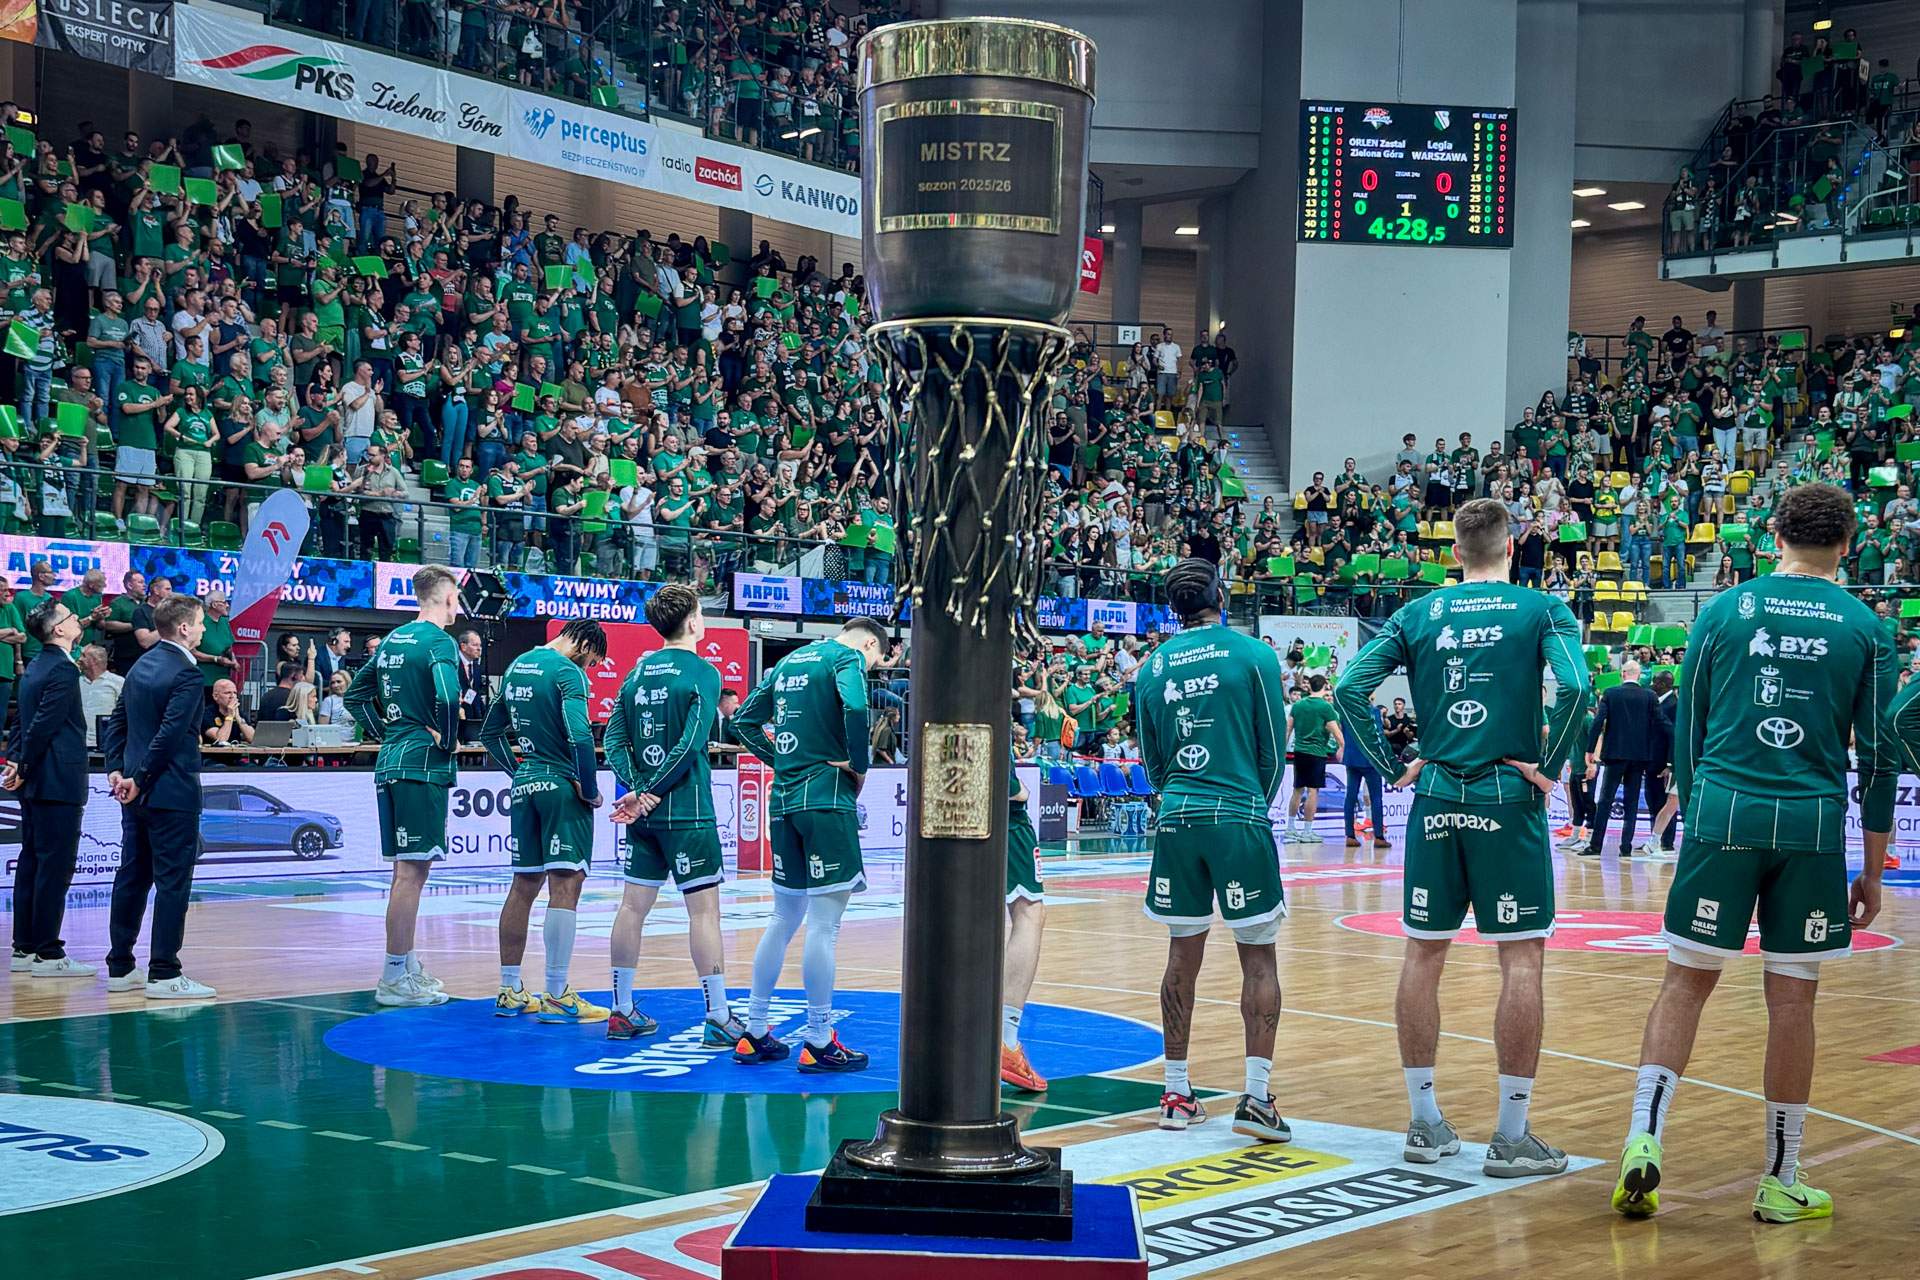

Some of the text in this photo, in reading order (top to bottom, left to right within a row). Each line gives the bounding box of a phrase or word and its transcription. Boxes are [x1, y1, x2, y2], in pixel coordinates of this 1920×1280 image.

[65, 23, 146, 54] EKSPERT OPTYK
[294, 62, 503, 138] PKS Zielona Góra
[1310, 116, 1317, 124] 0
[1474, 122, 1481, 130] 0
[1310, 126, 1316, 134] 3
[560, 119, 647, 155] perceptus
[1310, 136, 1316, 144] 4
[1349, 138, 1406, 148] ORLEN Zastal
[1474, 133, 1480, 141] 1
[920, 142, 1011, 162] MISTRZ
[1309, 147, 1316, 155] 6
[1427, 140, 1453, 151] Legia
[1474, 143, 1480, 151] 3
[1350, 149, 1404, 158] Zielona Góra
[1411, 151, 1468, 162] WARSZAWA
[1474, 153, 1479, 161] 5
[1309, 157, 1316, 165] 7
[662, 155, 739, 186] radio zachód
[1474, 164, 1479, 172] 7
[1306, 178, 1317, 186] 10
[1361, 169, 1378, 191] 0
[1436, 172, 1452, 193] 0
[1471, 174, 1481, 182] 15
[918, 179, 1012, 193] sezon 2025/26
[782, 180, 858, 216] KANWOD
[1306, 189, 1317, 197] 12
[1354, 200, 1367, 216] 0
[1401, 201, 1411, 217] 1
[1447, 203, 1459, 218] 0
[1305, 230, 1316, 238] 77
[1368, 217, 1445, 244] 4:28,5
[1468, 226, 1480, 234] 42
[553, 579, 621, 600] ŻYWIMY
[743, 584, 790, 600] ARPOL
[1450, 596, 1503, 606] TRAMWAJE
[1764, 597, 1826, 610] TRAMWAJE
[535, 600, 636, 620] BOHATERÓW
[1450, 603, 1518, 613] WARSZAWSKIE
[1764, 605, 1844, 623] WARSZAWSKIE
[1093, 609, 1128, 623] ARPOL
[236, 626, 261, 639] ORLEN
[1462, 625, 1503, 643] BYŚ
[1169, 644, 1215, 661] TRAMWAJE
[1780, 636, 1828, 656] BYŚ
[1169, 650, 1229, 667] WARSZAWSKIE
[786, 673, 808, 687] BYŚ
[1184, 673, 1219, 693] BYŚ
[1424, 813, 1490, 833] pompax
[1691, 926, 1717, 937] TERMIKA
[1692, 920, 1717, 931] ORLEN
